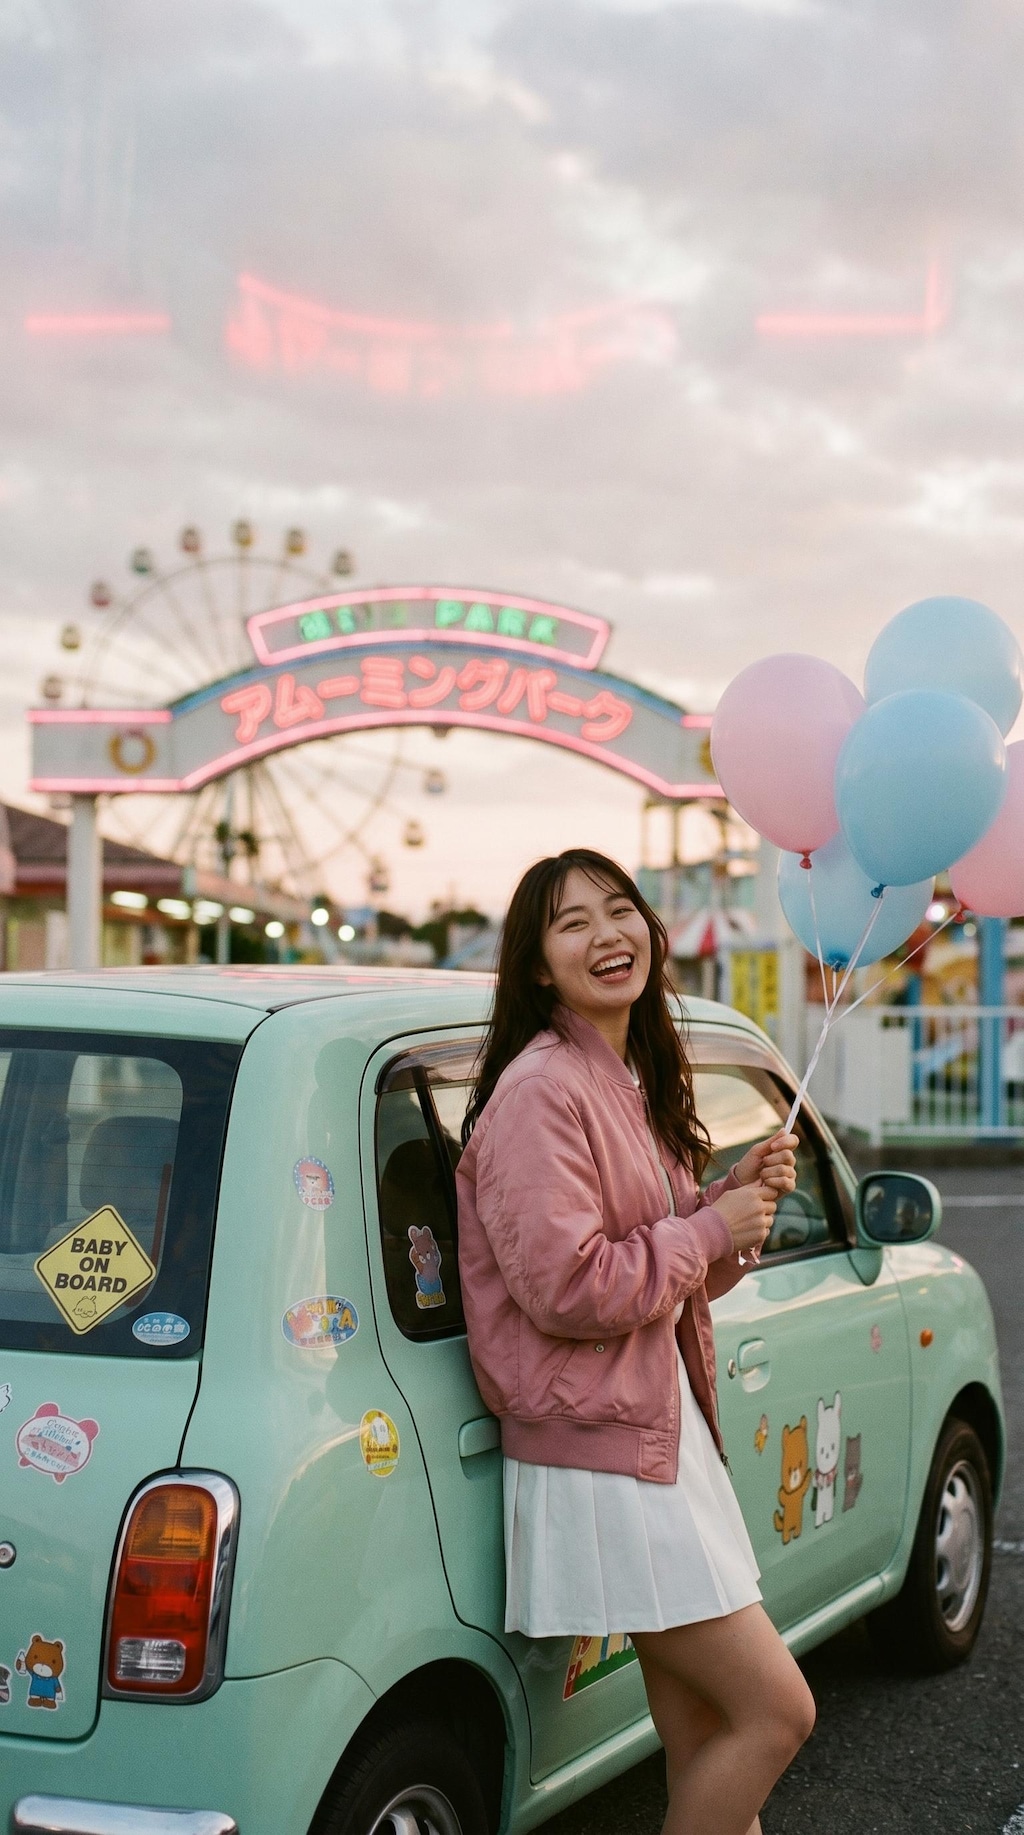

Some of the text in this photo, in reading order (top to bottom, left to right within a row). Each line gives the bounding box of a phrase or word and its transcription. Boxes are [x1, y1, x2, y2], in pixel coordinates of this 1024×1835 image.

[435, 599, 559, 645] PARK
[70, 1237, 128, 1256] BABY
[78, 1256, 110, 1274] ON
[54, 1273, 128, 1294] BOARD
